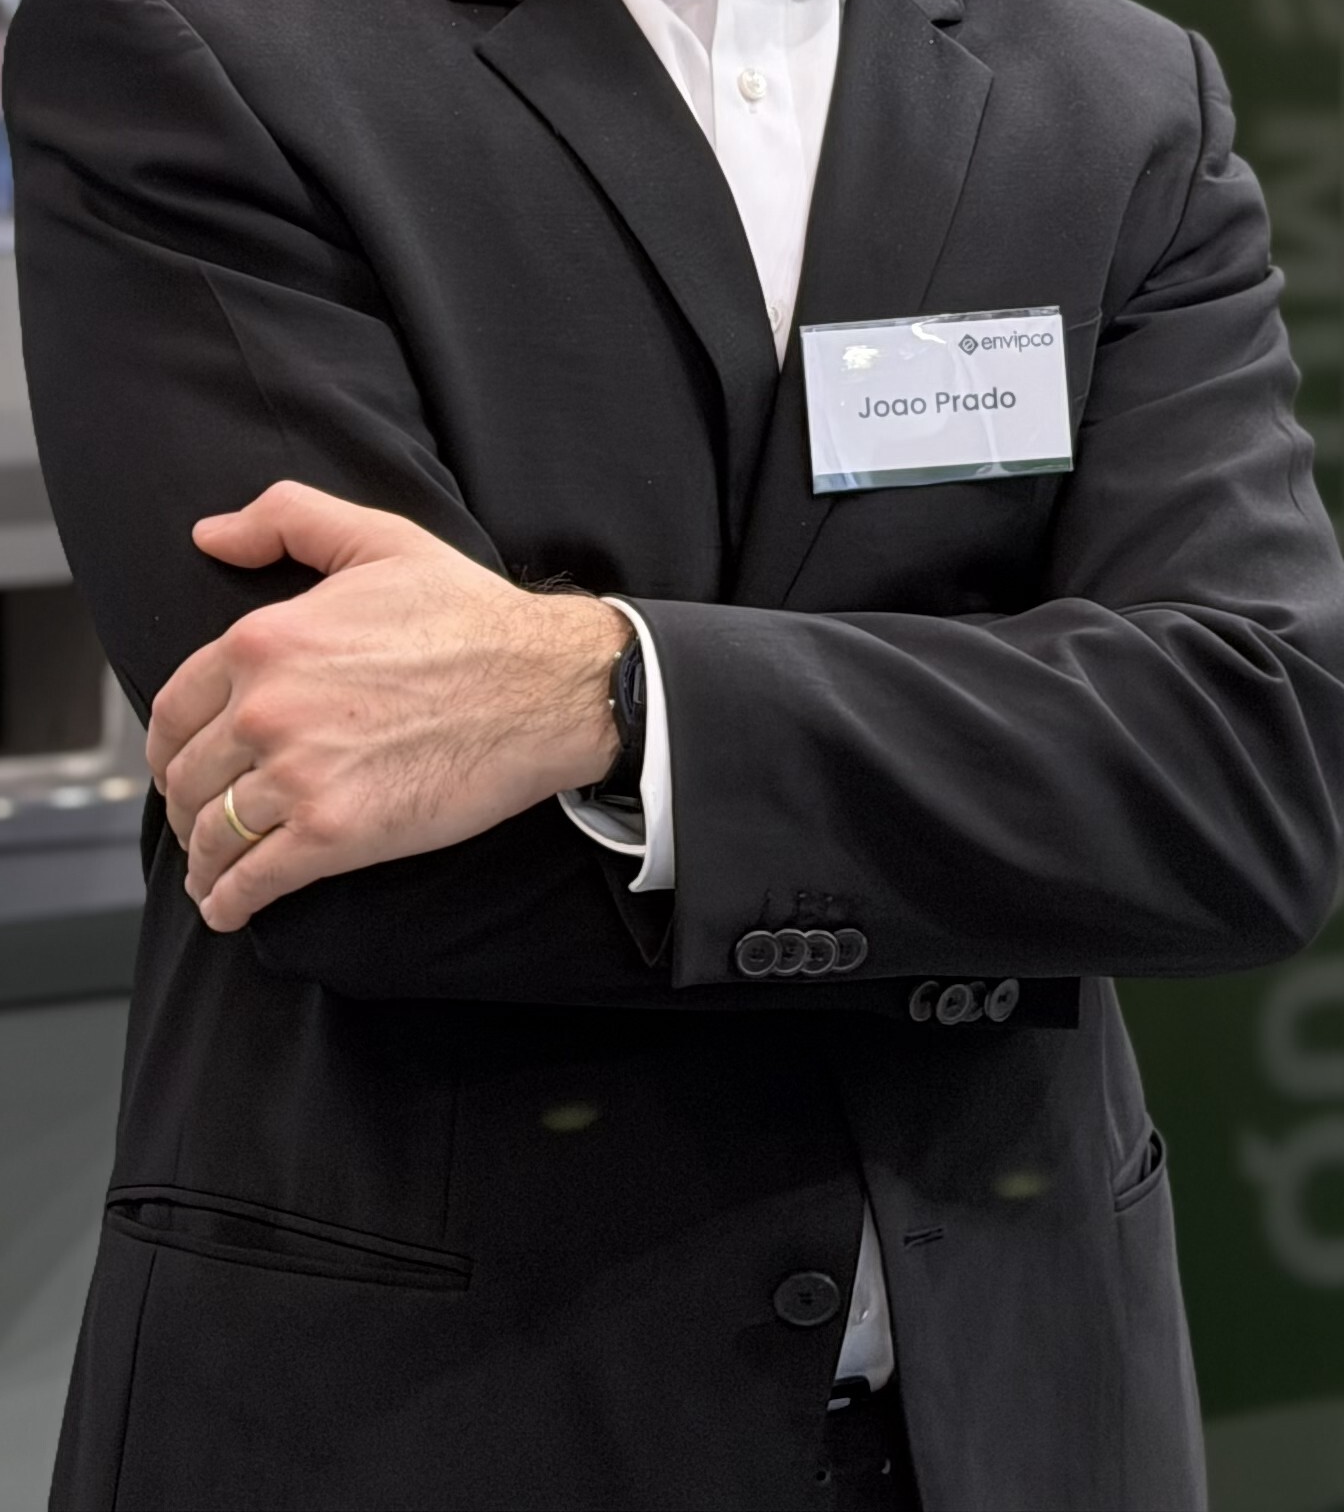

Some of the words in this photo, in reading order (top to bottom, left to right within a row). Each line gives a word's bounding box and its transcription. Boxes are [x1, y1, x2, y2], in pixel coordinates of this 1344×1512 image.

[981, 330, 1054, 352] envipco
[858, 396, 927, 419] Joao
[935, 387, 1017, 414] Prado
